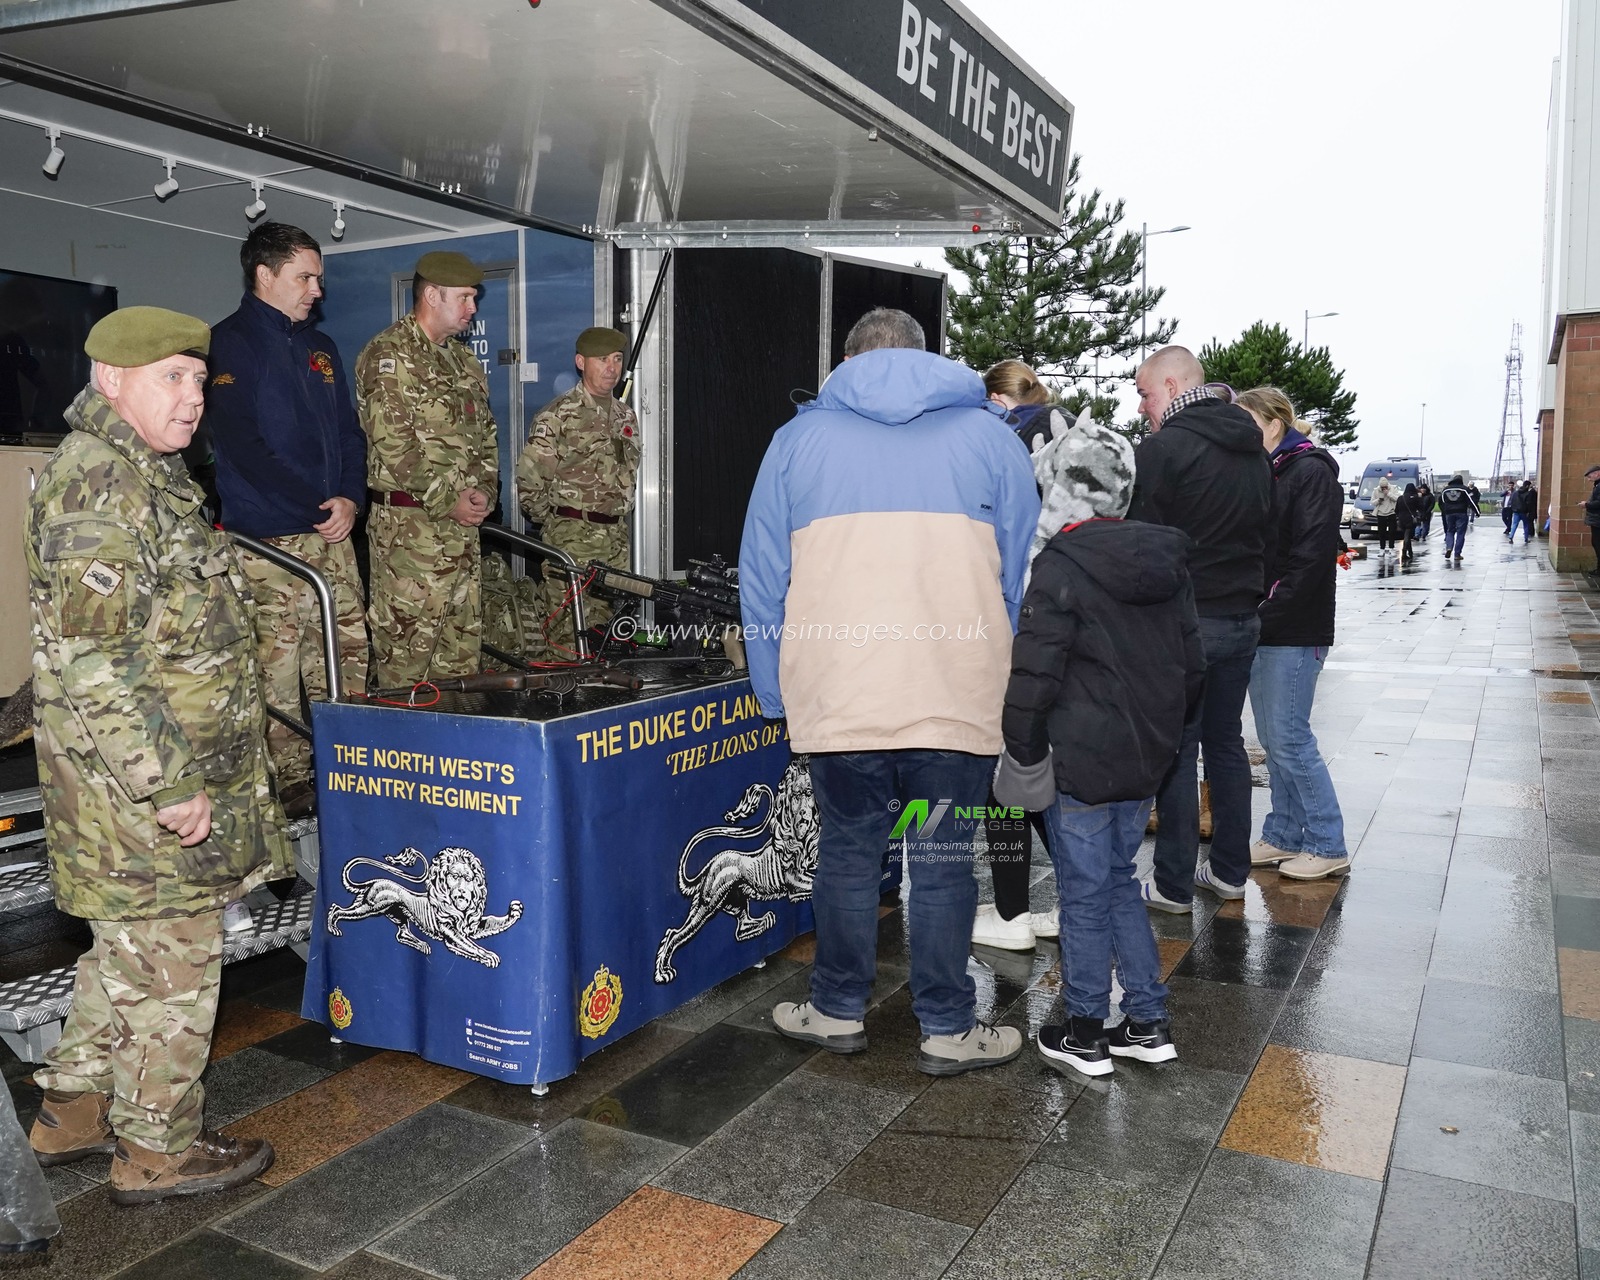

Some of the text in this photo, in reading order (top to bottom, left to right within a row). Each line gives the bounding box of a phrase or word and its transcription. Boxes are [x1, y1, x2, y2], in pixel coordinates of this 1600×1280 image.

[897, 0, 1062, 187] BE THE BEST
[471, 339, 489, 356] TO
[576, 724, 623, 763] THE
[629, 709, 686, 751] DUKE
[691, 702, 717, 732] OF
[709, 729, 759, 764] LIONS
[761, 723, 782, 747] OF
[333, 744, 368, 767] THE
[373, 748, 435, 775] NORTH
[328, 772, 522, 816] INFANTRY REGIMENT
[469, 1052, 518, 1070] Search ARMY JOBS
